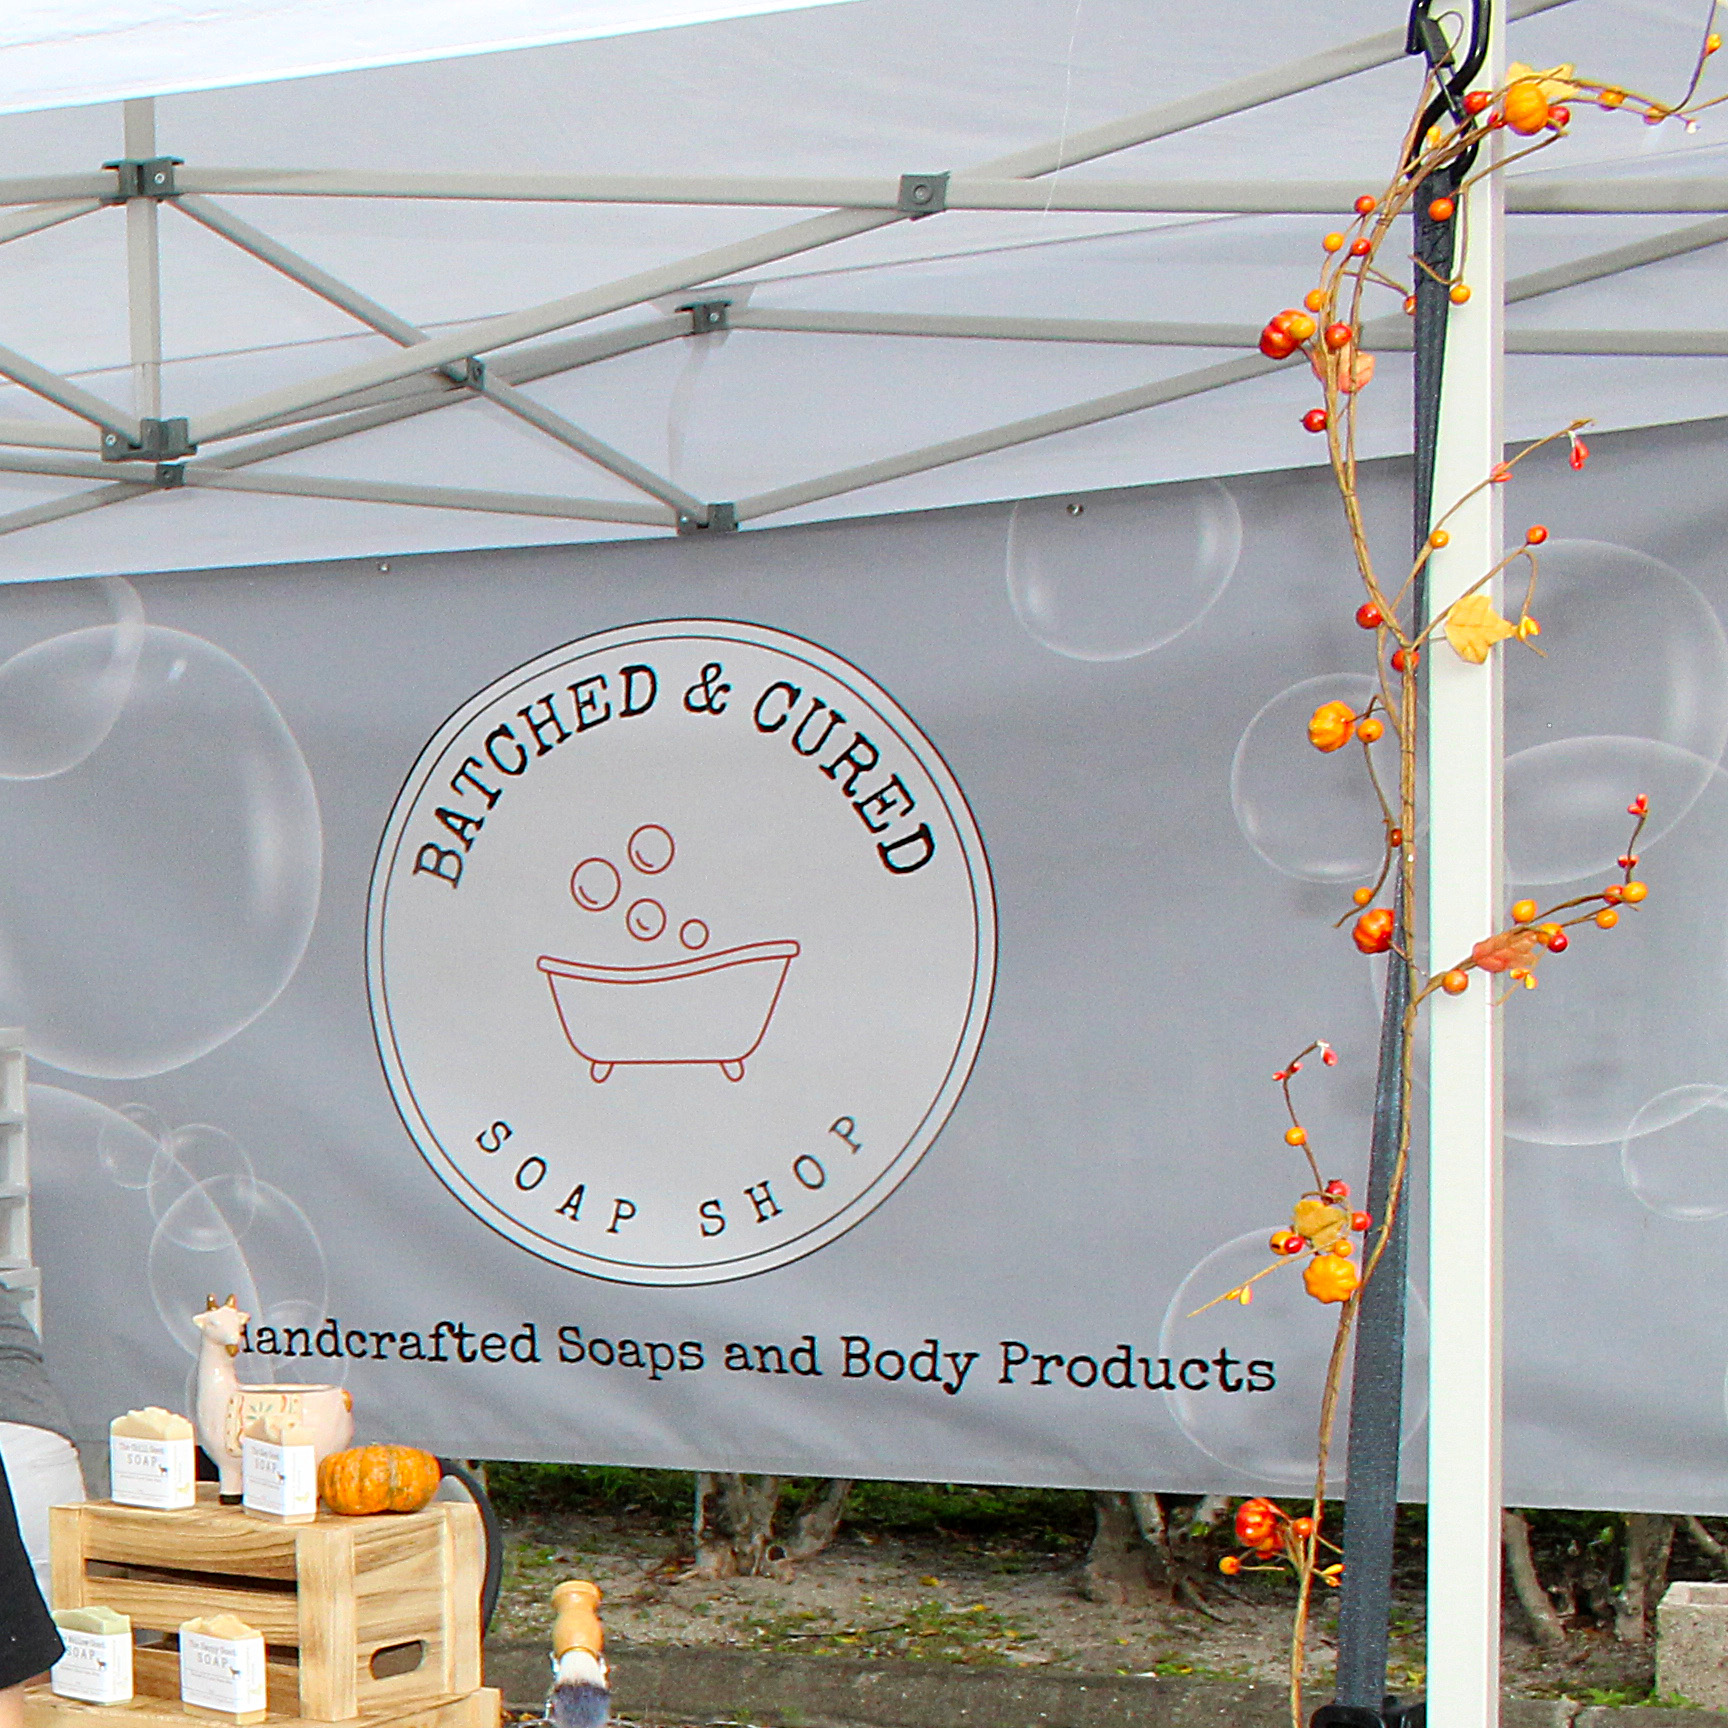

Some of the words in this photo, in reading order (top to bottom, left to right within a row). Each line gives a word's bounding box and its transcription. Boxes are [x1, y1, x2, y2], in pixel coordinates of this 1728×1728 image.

[412, 662, 659, 889] BATCHED
[684, 663, 731, 715] &
[752, 679, 935, 878] CURED
[476, 1120, 638, 1234] SOAP
[697, 1114, 866, 1237] SHOP
[559, 1326, 704, 1381] Soaps
[725, 1336, 823, 1376] and
[841, 1336, 979, 1395] Body
[999, 1342, 1275, 1392] Products
[127, 1453, 158, 1467] SOAP
[67, 1646, 96, 1660] SOAP
[197, 1651, 229, 1668] SOAP
